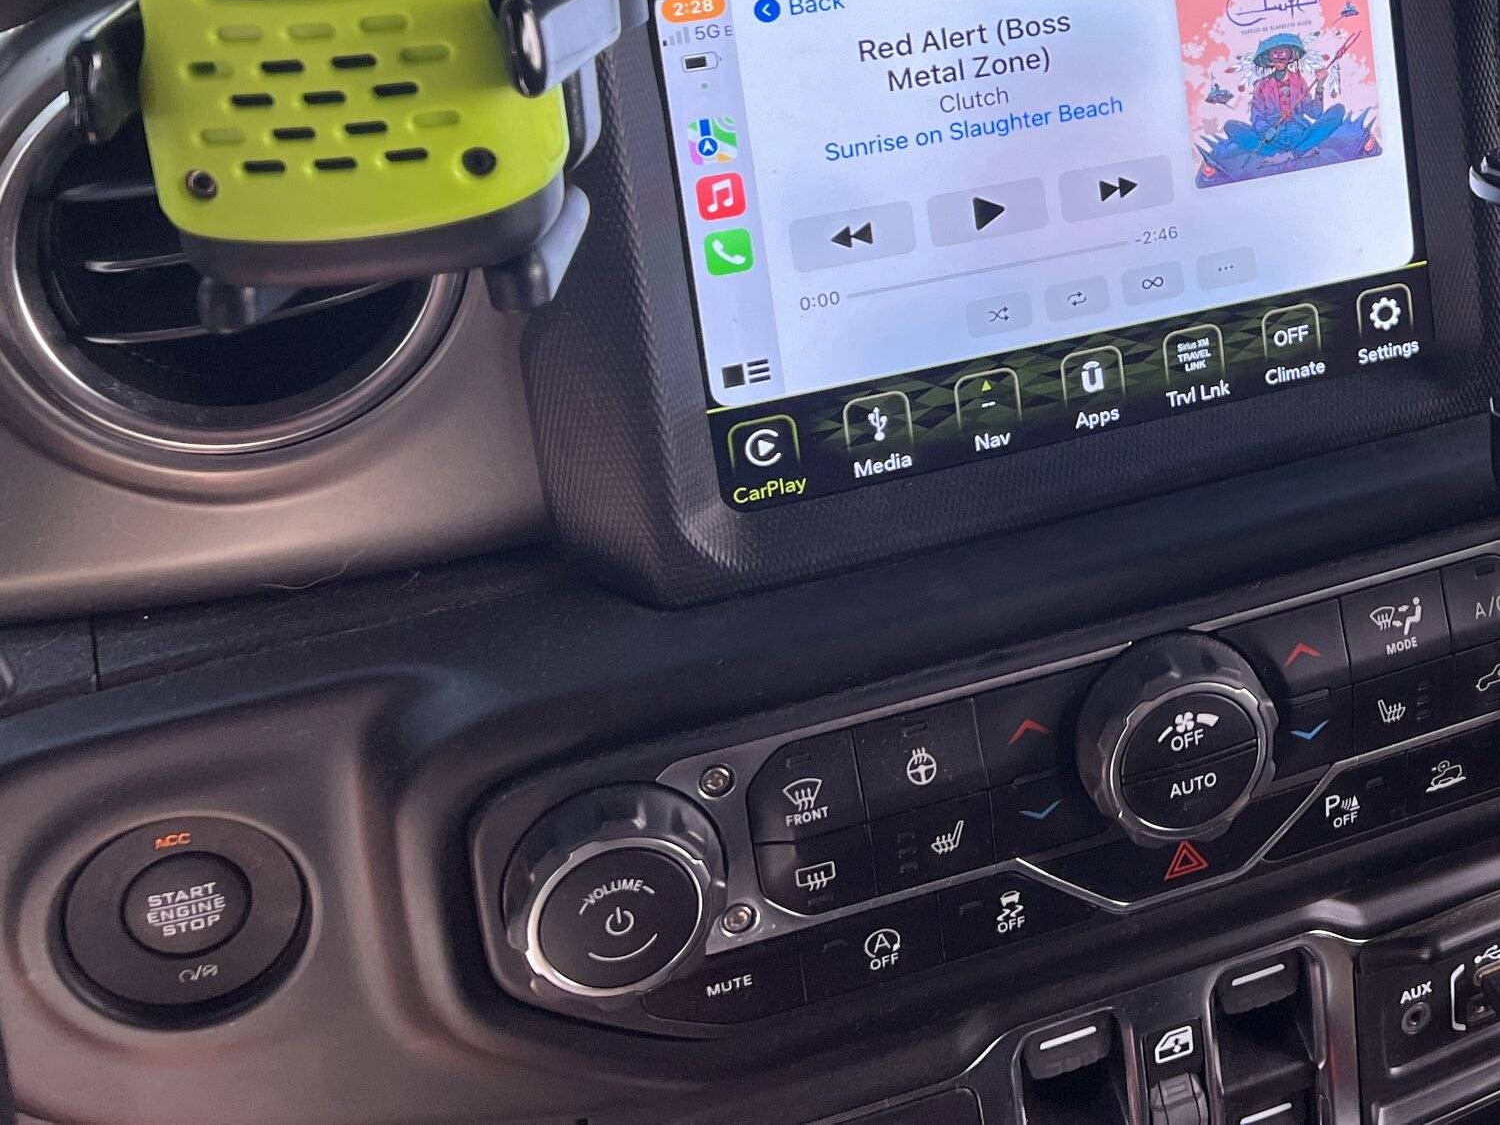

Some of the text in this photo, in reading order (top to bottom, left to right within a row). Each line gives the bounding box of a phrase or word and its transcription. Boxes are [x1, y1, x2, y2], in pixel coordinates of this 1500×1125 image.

[672, 0, 714, 17] 2:28
[695, 25, 734, 41] 5G E
[858, 15, 1071, 62] Red Alert (Boss
[887, 46, 1051, 92] Metal Zone)
[939, 87, 1010, 114] Clutch
[825, 96, 1123, 161] Sunrise on Slaughter Beach
[1135, 226, 1179, 245] -2:46
[799, 291, 841, 312] 0:00
[1273, 325, 1309, 348] OFF
[1177, 348, 1212, 364] TRAVEL
[1357, 339, 1420, 366] Settings
[1184, 358, 1207, 373] LINK
[1265, 360, 1326, 386] Climate
[1166, 378, 1231, 408] Trvl Lnk
[1075, 405, 1120, 431] Apps
[974, 432, 1011, 452] Nav
[853, 452, 913, 478] Media
[732, 476, 808, 504] CarPlay
[1386, 636, 1419, 656] MODE
[1170, 730, 1205, 752] OFF
[1169, 772, 1218, 799] AUTO
[785, 805, 829, 827] FRONT
[1325, 794, 1341, 818] P
[1333, 811, 1359, 829] OFF
[155, 832, 192, 851] ACC
[147, 881, 217, 908] START
[582, 878, 645, 906] VOLUME
[146, 895, 227, 925] ENGINE
[162, 913, 221, 937] STOP
[997, 915, 1025, 934] OFF
[870, 952, 899, 971] OFF
[706, 974, 754, 998] MUTE
[1399, 979, 1434, 1005] AUX
